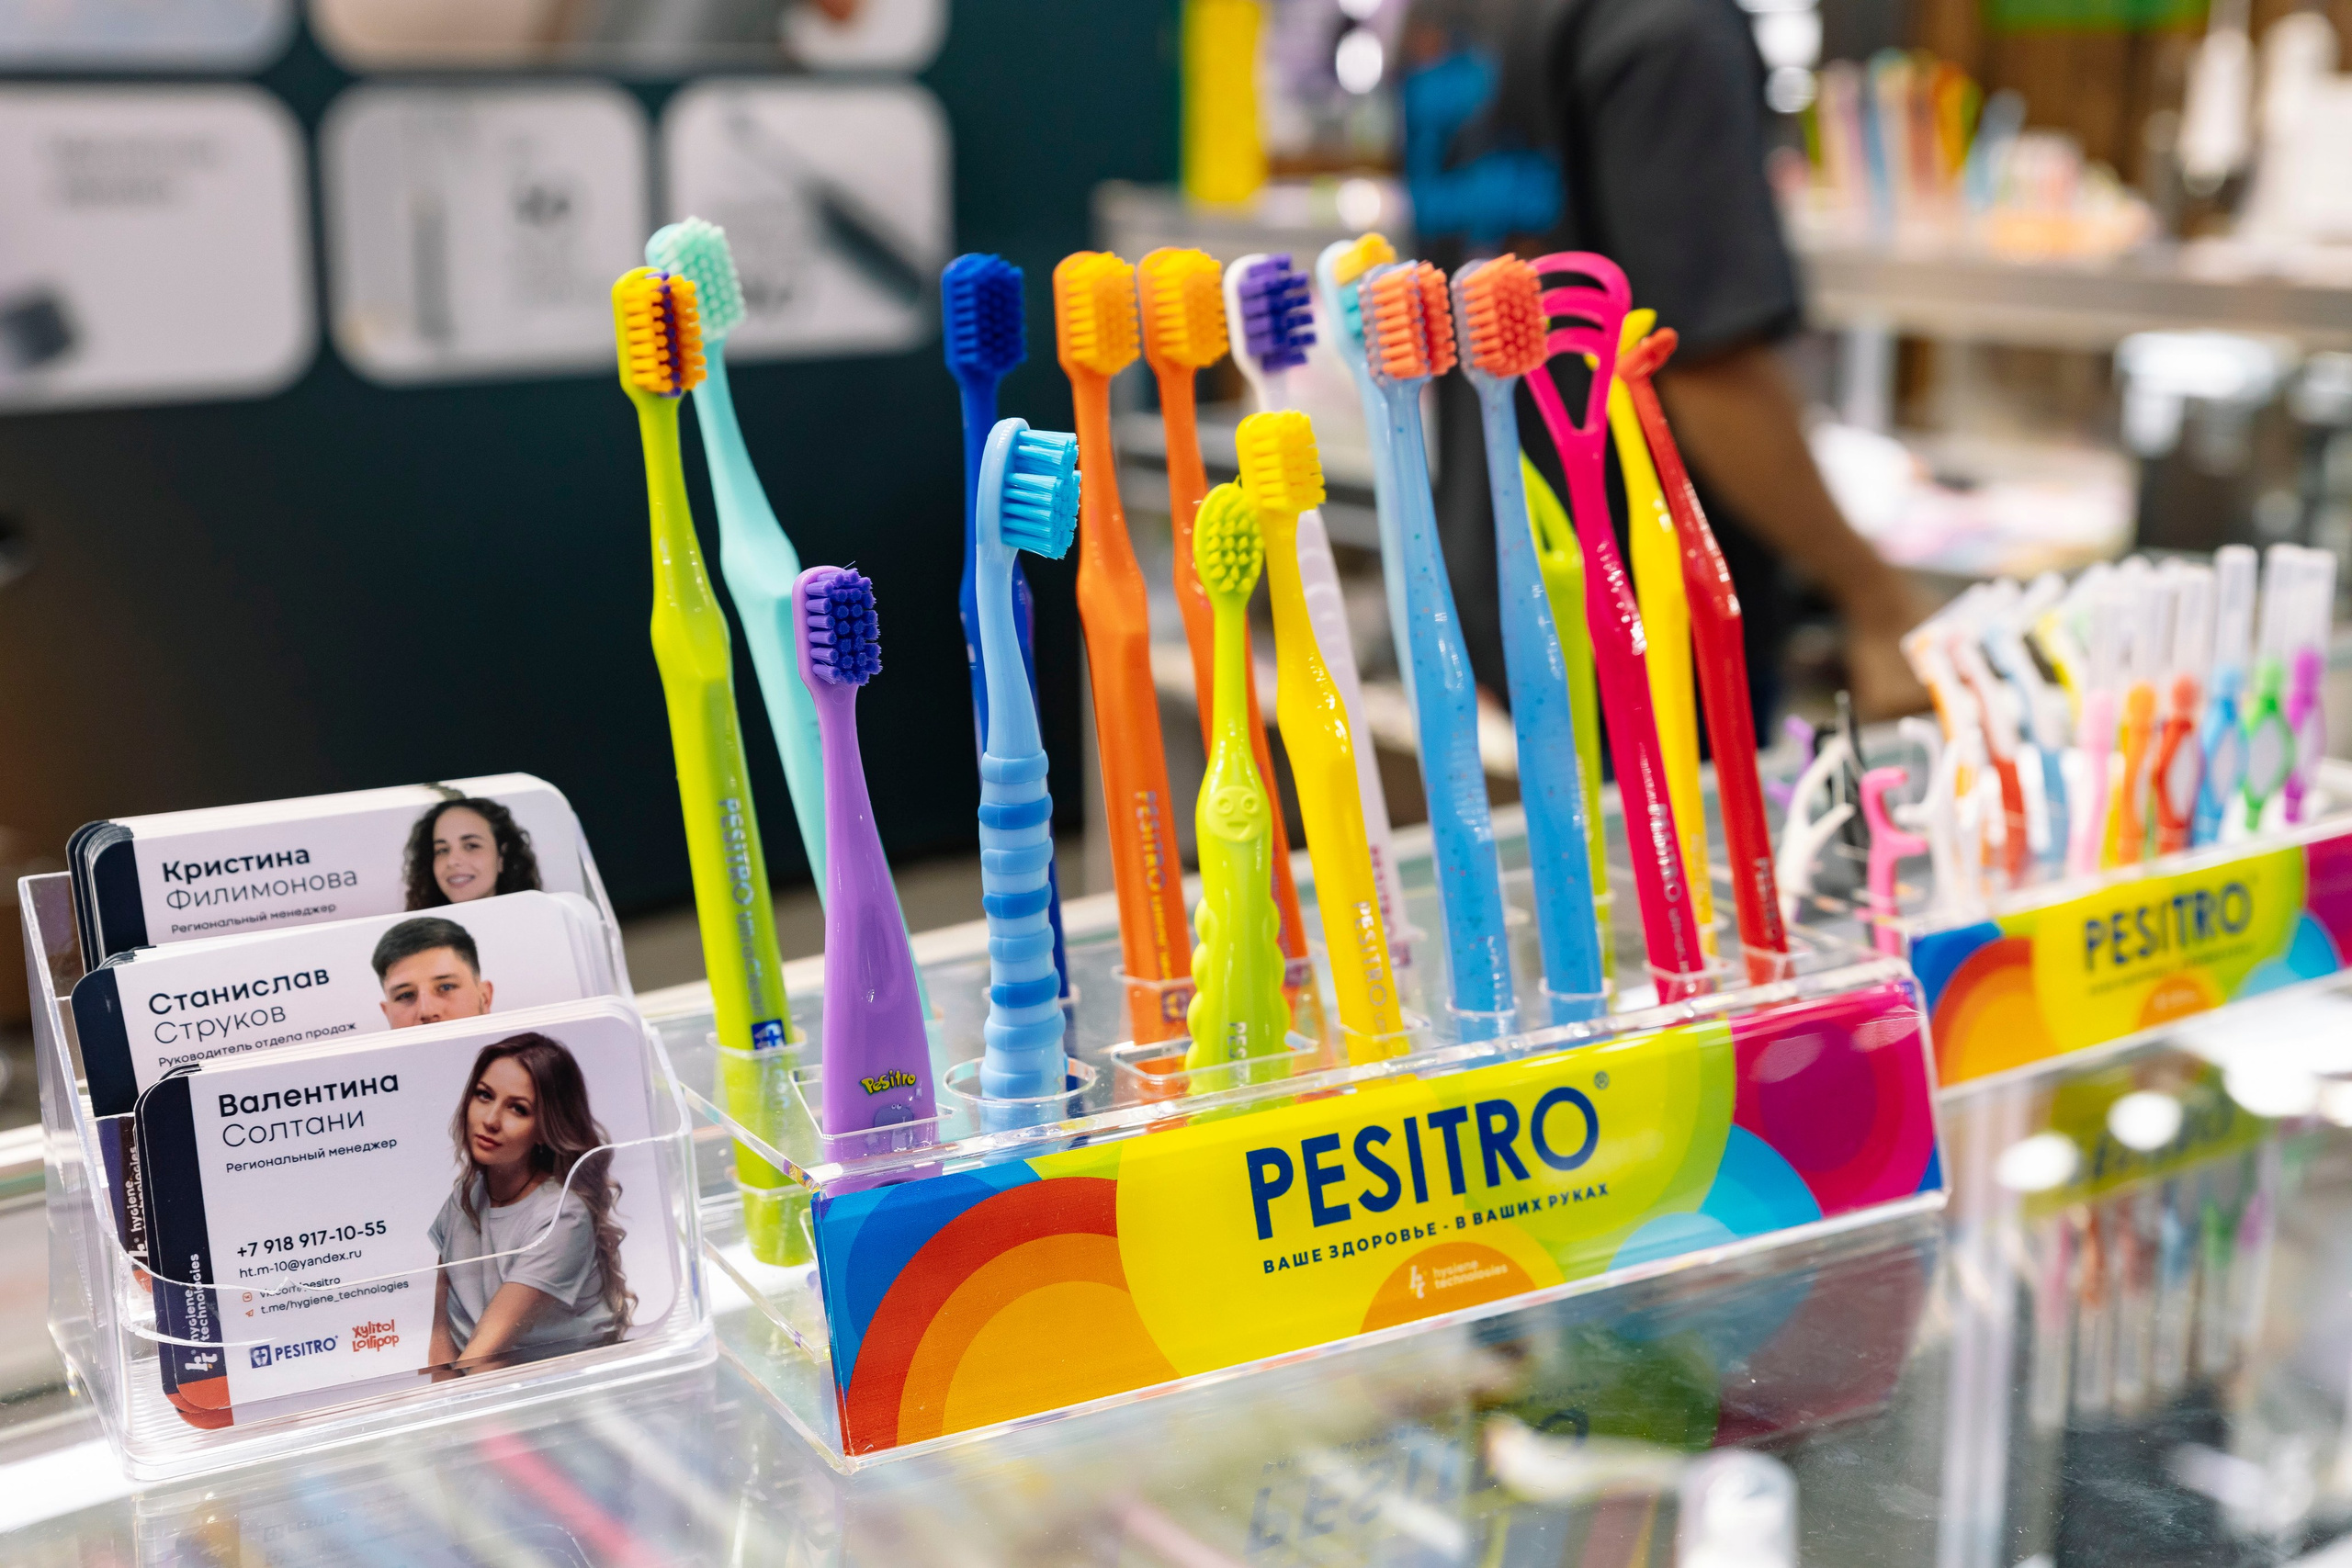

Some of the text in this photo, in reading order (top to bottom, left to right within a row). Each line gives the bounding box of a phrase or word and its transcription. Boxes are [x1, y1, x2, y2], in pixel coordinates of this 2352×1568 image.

[162, 848, 311, 885] Кристина
[718, 797, 754, 906] PESITRO
[165, 869, 357, 910] Филимонова
[171, 903, 336, 934] Региональный менеджер
[2084, 881, 2254, 974] PESITRO
[1351, 900, 1387, 1007] PESITRO
[148, 968, 330, 1015] Станислав
[154, 1006, 287, 1044] Струков
[158, 1021, 356, 1067] Руководитель отдела продаж
[219, 1074, 400, 1118] Валентина
[859, 1069, 917, 1096] Pesitro
[222, 1110, 365, 1147] Солтани
[226, 1138, 398, 1173] Региональный менеджер
[1245, 1086, 1600, 1240] PESITRO
[125, 1179, 142, 1233] hygiene
[237, 1220, 387, 1258] +7 918 917-10-55
[1263, 1247, 1323, 1274] ВАШЕ
[1329, 1222, 1438, 1259] ЗДОРОВЬЕ
[1455, 1214, 1467, 1230] В
[1473, 1197, 1544, 1226] ВАШИХ
[1548, 1181, 1610, 1209] РУКАХ
[239, 1249, 363, 1279] ht.m-10@yandex.ru
[261, 1279, 410, 1314] t.me/hygiene_technologies
[275, 1337, 337, 1361] PESITRO
